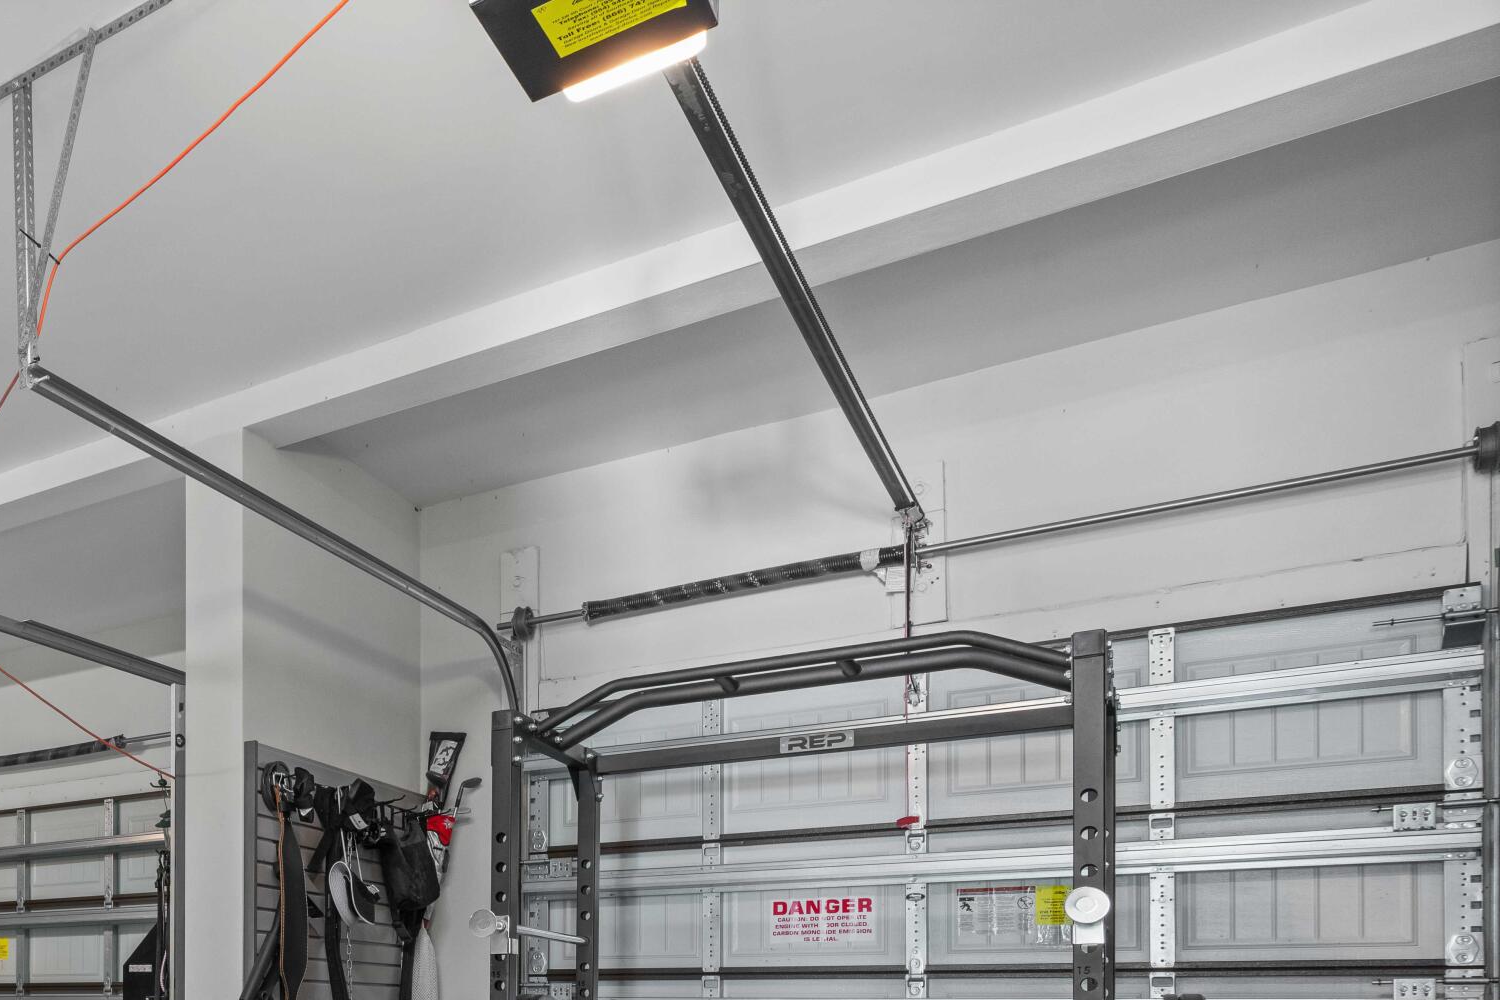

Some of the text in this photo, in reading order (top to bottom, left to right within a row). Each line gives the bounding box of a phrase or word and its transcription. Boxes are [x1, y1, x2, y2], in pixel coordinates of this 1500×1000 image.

[556, 31, 574, 41] Toll
[787, 732, 847, 751] REP
[773, 897, 872, 916] DANGER
[1077, 966, 1091, 975] 15
